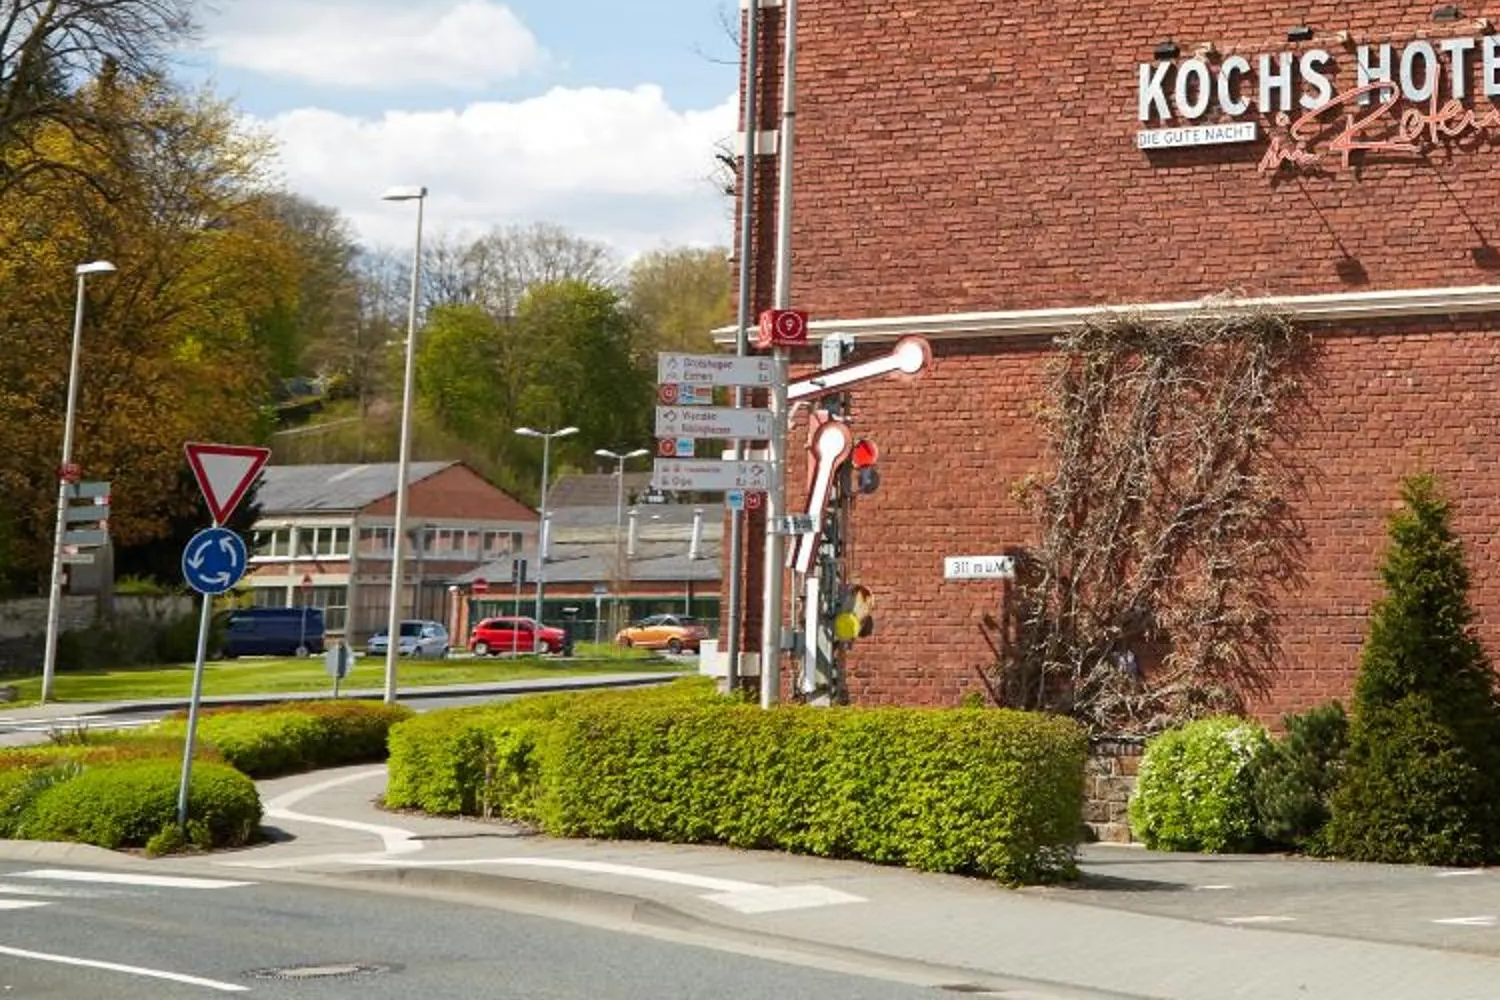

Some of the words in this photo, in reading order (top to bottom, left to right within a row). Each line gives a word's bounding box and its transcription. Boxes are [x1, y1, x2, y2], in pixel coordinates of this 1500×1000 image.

[1138, 49, 1334, 121] KOCHS
[1140, 133, 1160, 146] DIE
[1164, 130, 1201, 144] GUTE
[1205, 126, 1253, 140] NACHT
